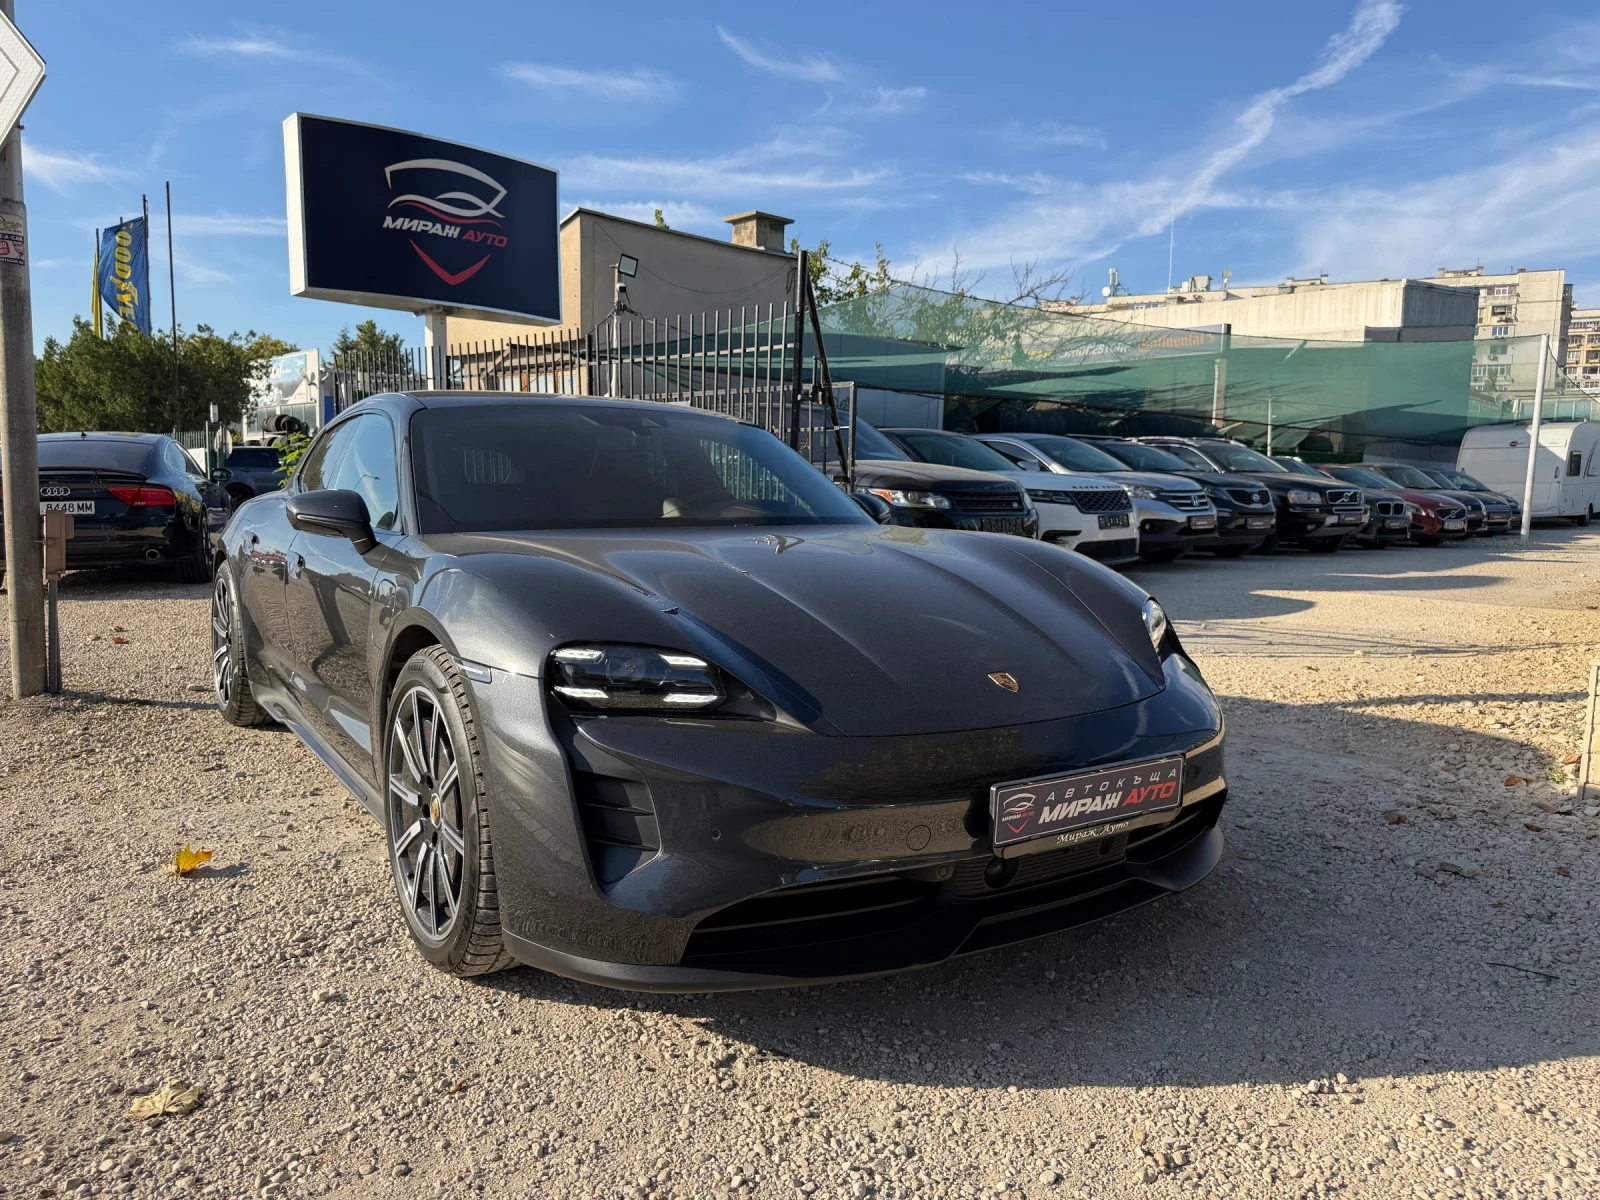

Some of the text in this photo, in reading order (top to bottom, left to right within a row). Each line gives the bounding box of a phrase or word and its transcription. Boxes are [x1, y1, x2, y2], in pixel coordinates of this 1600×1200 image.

[382, 215, 508, 248] МИРАЖ АУТО
[114, 222, 140, 331] OODYE
[46, 502, 93, 513] 8448 MM
[1038, 780, 1177, 825] МИРАЖ АУТО
